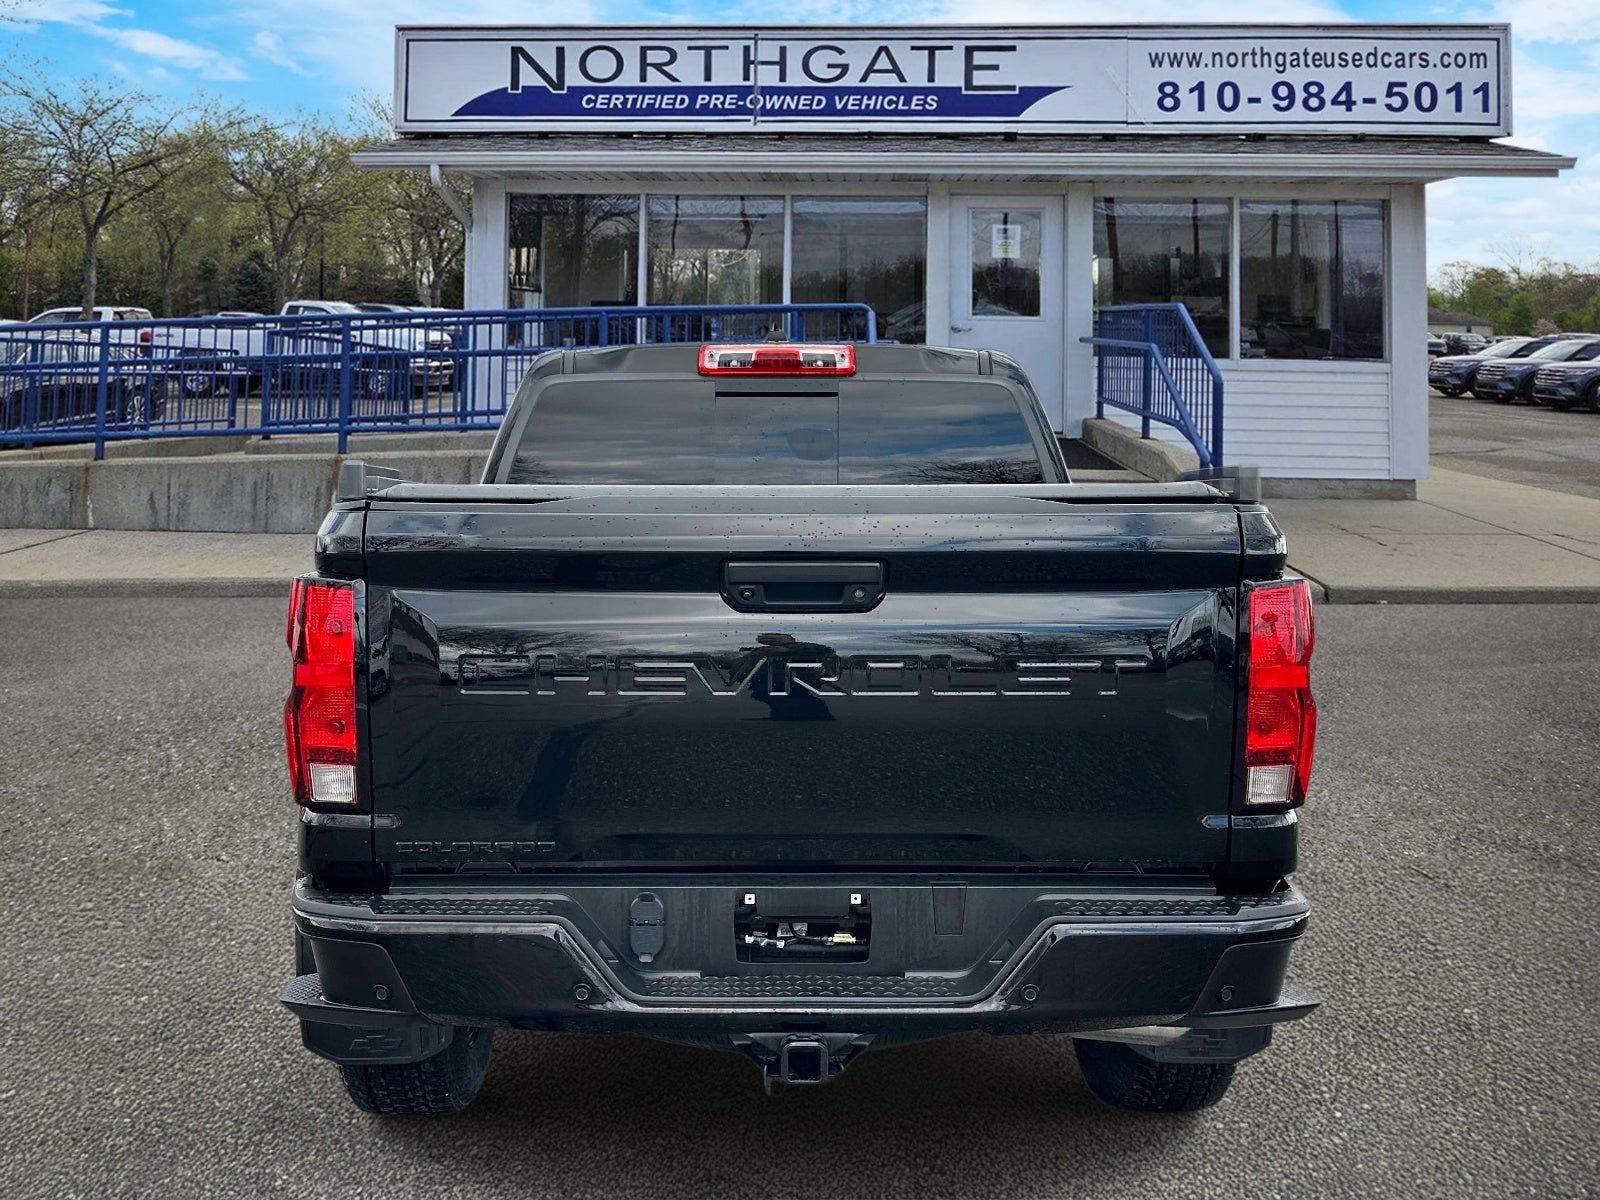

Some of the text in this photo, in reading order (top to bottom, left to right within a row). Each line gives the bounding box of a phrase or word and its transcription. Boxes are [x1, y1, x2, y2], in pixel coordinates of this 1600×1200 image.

[510, 44, 1017, 92] NORTHGATE
[1149, 47, 1488, 73] www.northgateusedcars.com
[581, 94, 939, 110] CERTIFIED PRE-OWNED VEHICLES
[1156, 80, 1491, 114] 810-984-5011
[457, 654, 1148, 696] CHEVROLET
[395, 841, 556, 853] COLORADO
